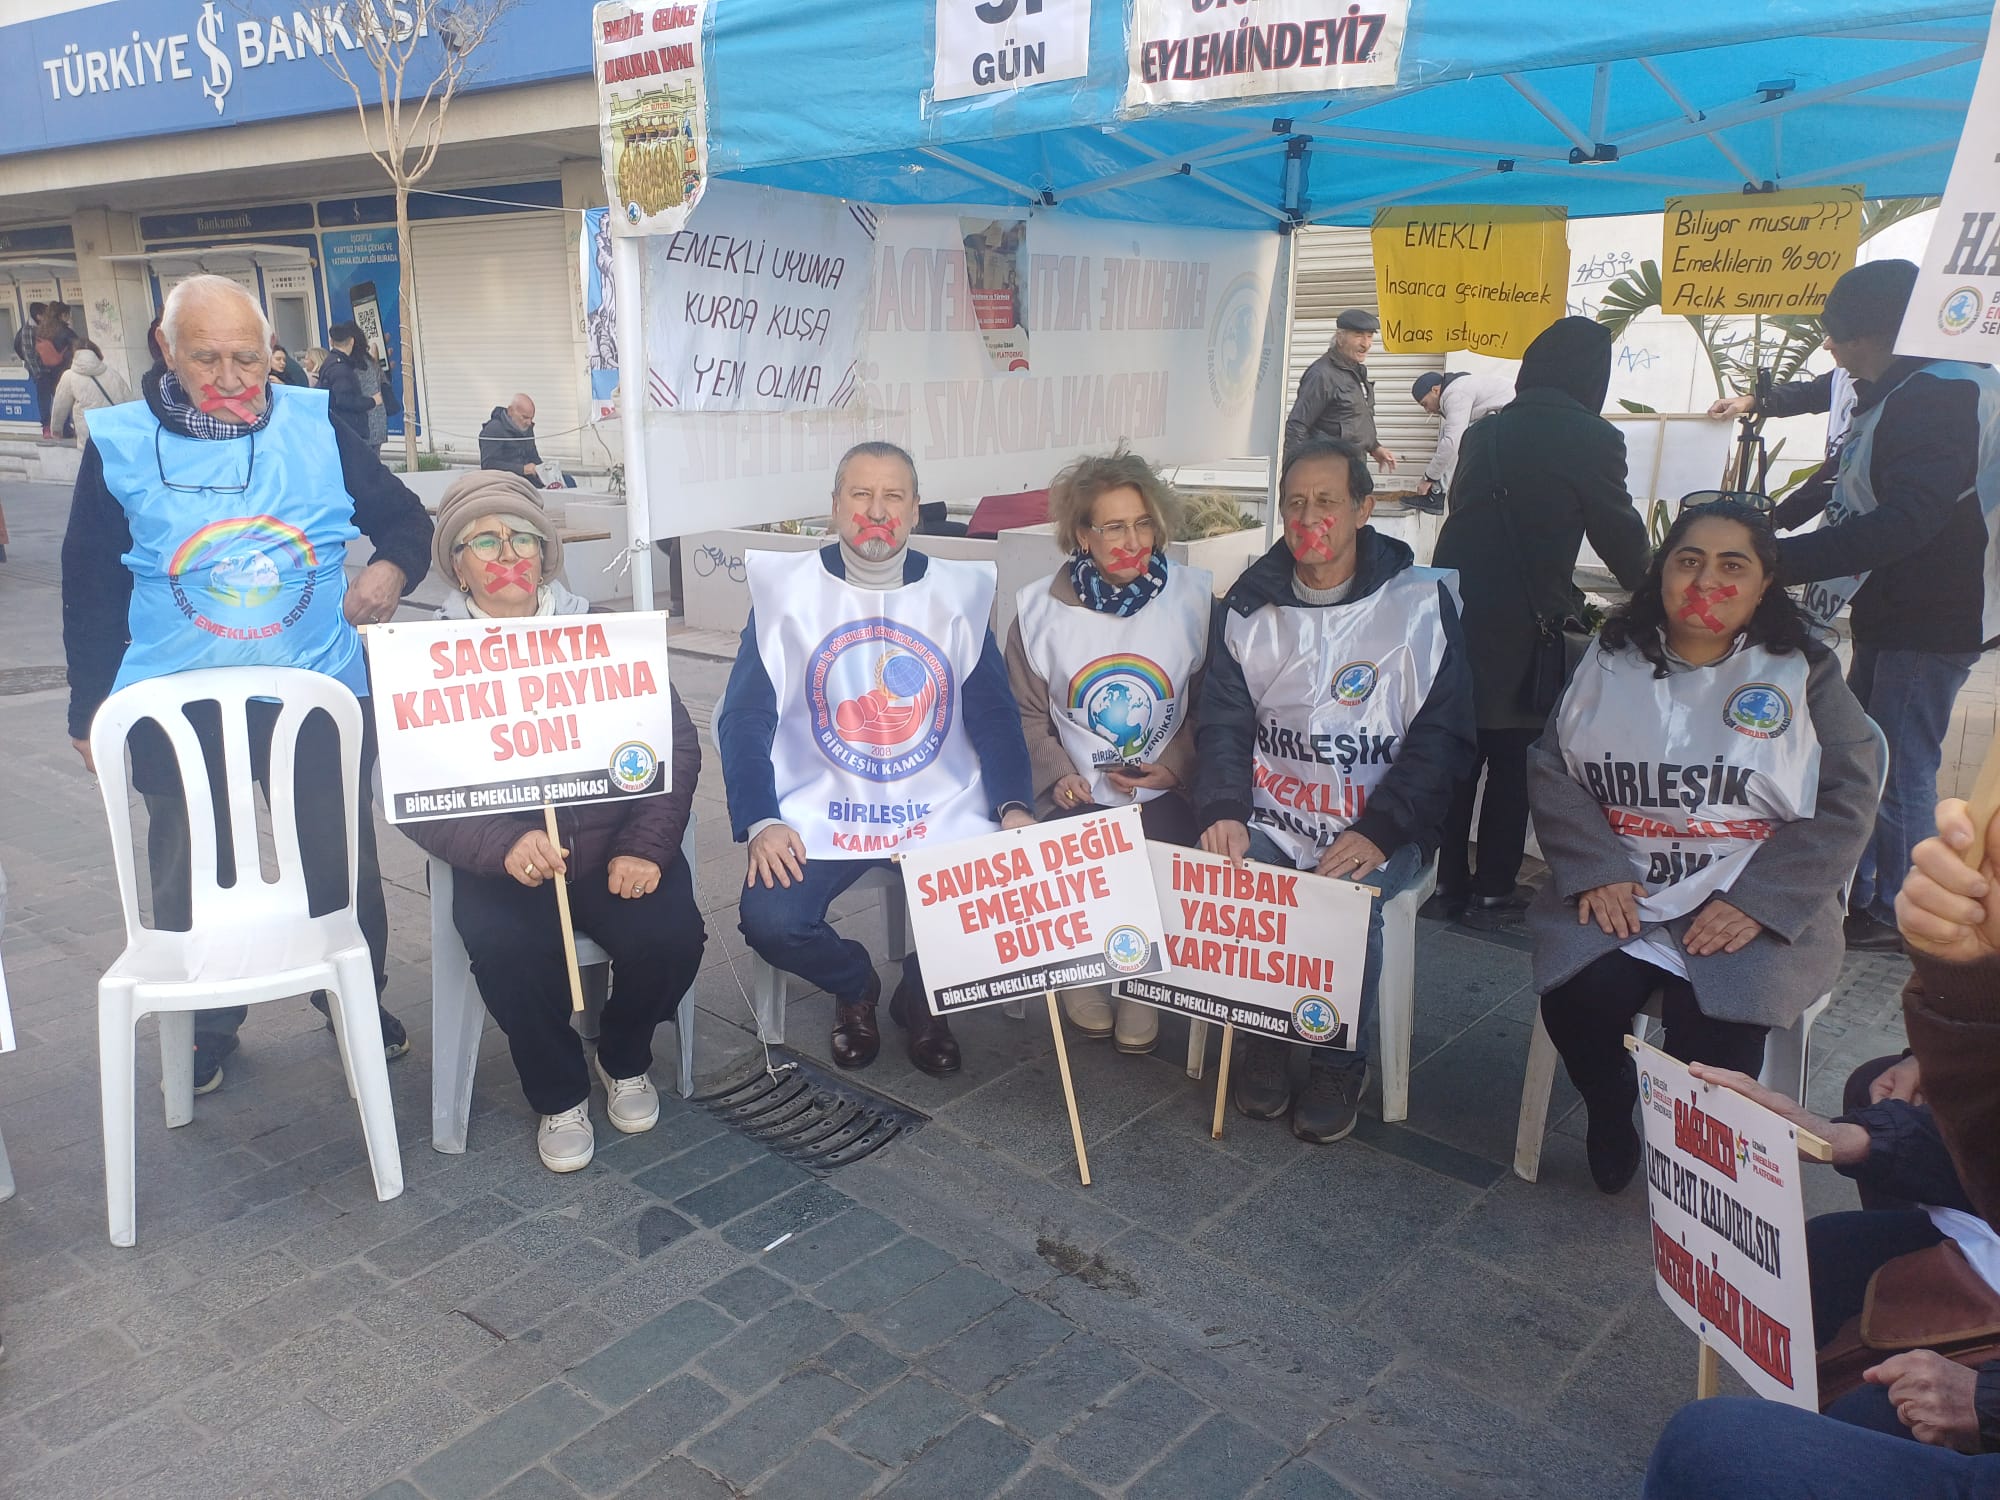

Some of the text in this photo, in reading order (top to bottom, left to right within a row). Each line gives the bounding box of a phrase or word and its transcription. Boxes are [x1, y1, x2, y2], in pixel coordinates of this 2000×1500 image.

[43, 31, 193, 100] TÜRKİYE
[236, 0, 429, 69] BANKASI
[972, 38, 1047, 87] GÜN
[1142, 4, 1386, 84] EYLEMİNDEYİZ
[197, 213, 251, 232] Bankamatik
[1405, 221, 1493, 251] EMEKLİ
[1675, 209, 1740, 241] Biliyor
[666, 230, 845, 290] EMEKLİ UYUMA
[1385, 265, 1446, 298] İnsanca
[1672, 245, 1772, 274] Emeklilerin
[1456, 281, 1552, 304] geçinebilecek
[685, 291, 831, 346] KURDA KUŞA
[1386, 320, 1433, 343] Maaş
[694, 354, 822, 404] YEM OLMA
[194, 615, 283, 641] EMEKLİLER
[430, 624, 610, 679] SAĞLIKTA
[393, 661, 657, 730] KATKI PAYINA
[490, 714, 581, 761] SON!
[821, 730, 939, 775] BİRLEŞİK KAMU-İŞ
[871, 746, 891, 756] 2008
[1144, 703, 1174, 758] SENDİKASI
[1258, 719, 1399, 775] BİRLEŞİK
[405, 778, 608, 814] BİRLEŞİK EMEKLİLER SENDİKASI
[1584, 752, 1755, 813] BİRLEŞİK
[828, 797, 931, 828] BİRLEŞİK
[917, 817, 1133, 906] SAVAŞA DEĞİL
[1173, 853, 1298, 908] İNTİBAK
[958, 866, 1110, 934] EMEKLİYE
[1180, 898, 1287, 945] YASASI
[994, 910, 1092, 964] BÜTÇE
[942, 962, 1106, 1006] BİRLEŞİK EMEKLİLER SENDİKASI
[1126, 981, 1289, 1034] BİRLEŞİK EMEKLİLER SENDİKASI
[1674, 1160, 1698, 1219] PAYI
[1701, 1177, 1781, 1279] KALDIRILSIN
